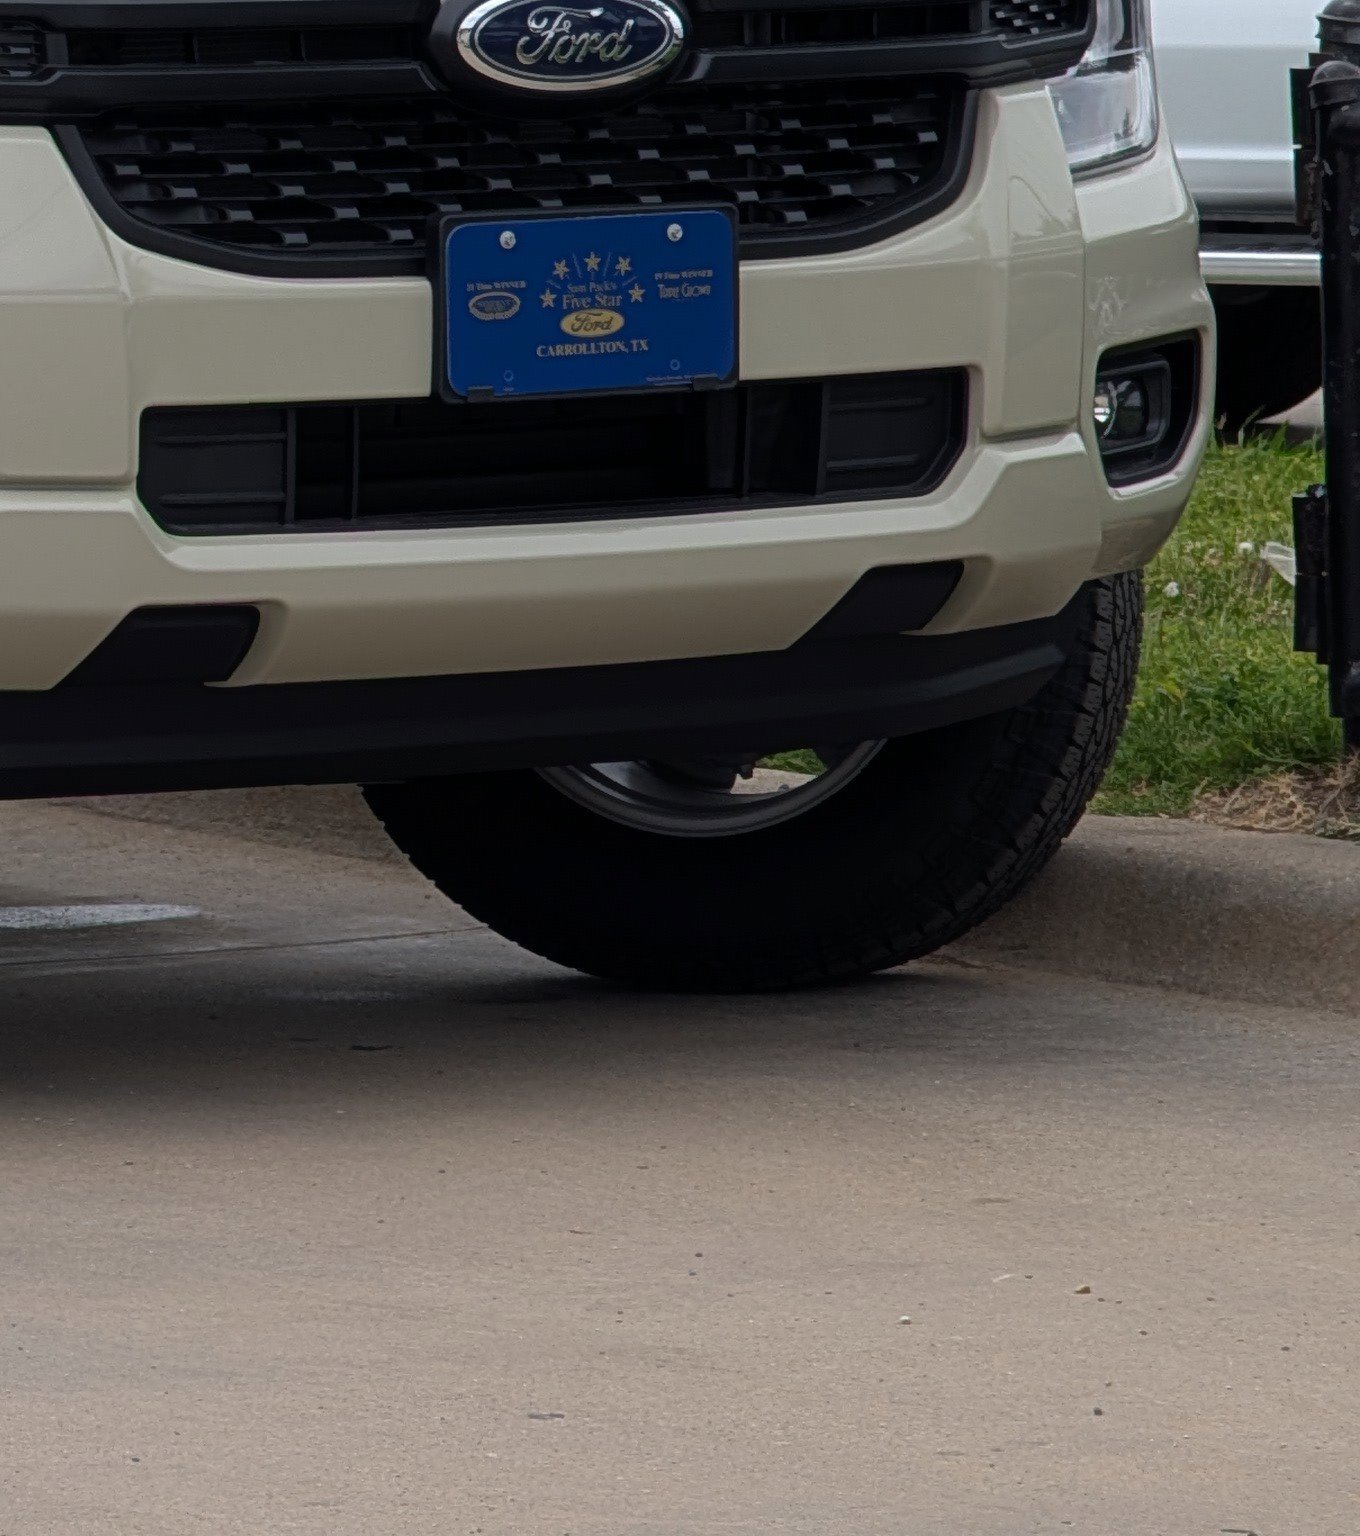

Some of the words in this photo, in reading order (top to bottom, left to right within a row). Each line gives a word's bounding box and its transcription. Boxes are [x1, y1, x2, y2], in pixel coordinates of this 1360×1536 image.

[516, 5, 634, 65] Ford
[562, 294, 592, 310] Five
[595, 292, 623, 307] Star
[571, 311, 613, 333] Ford
[630, 338, 649, 352] TX
